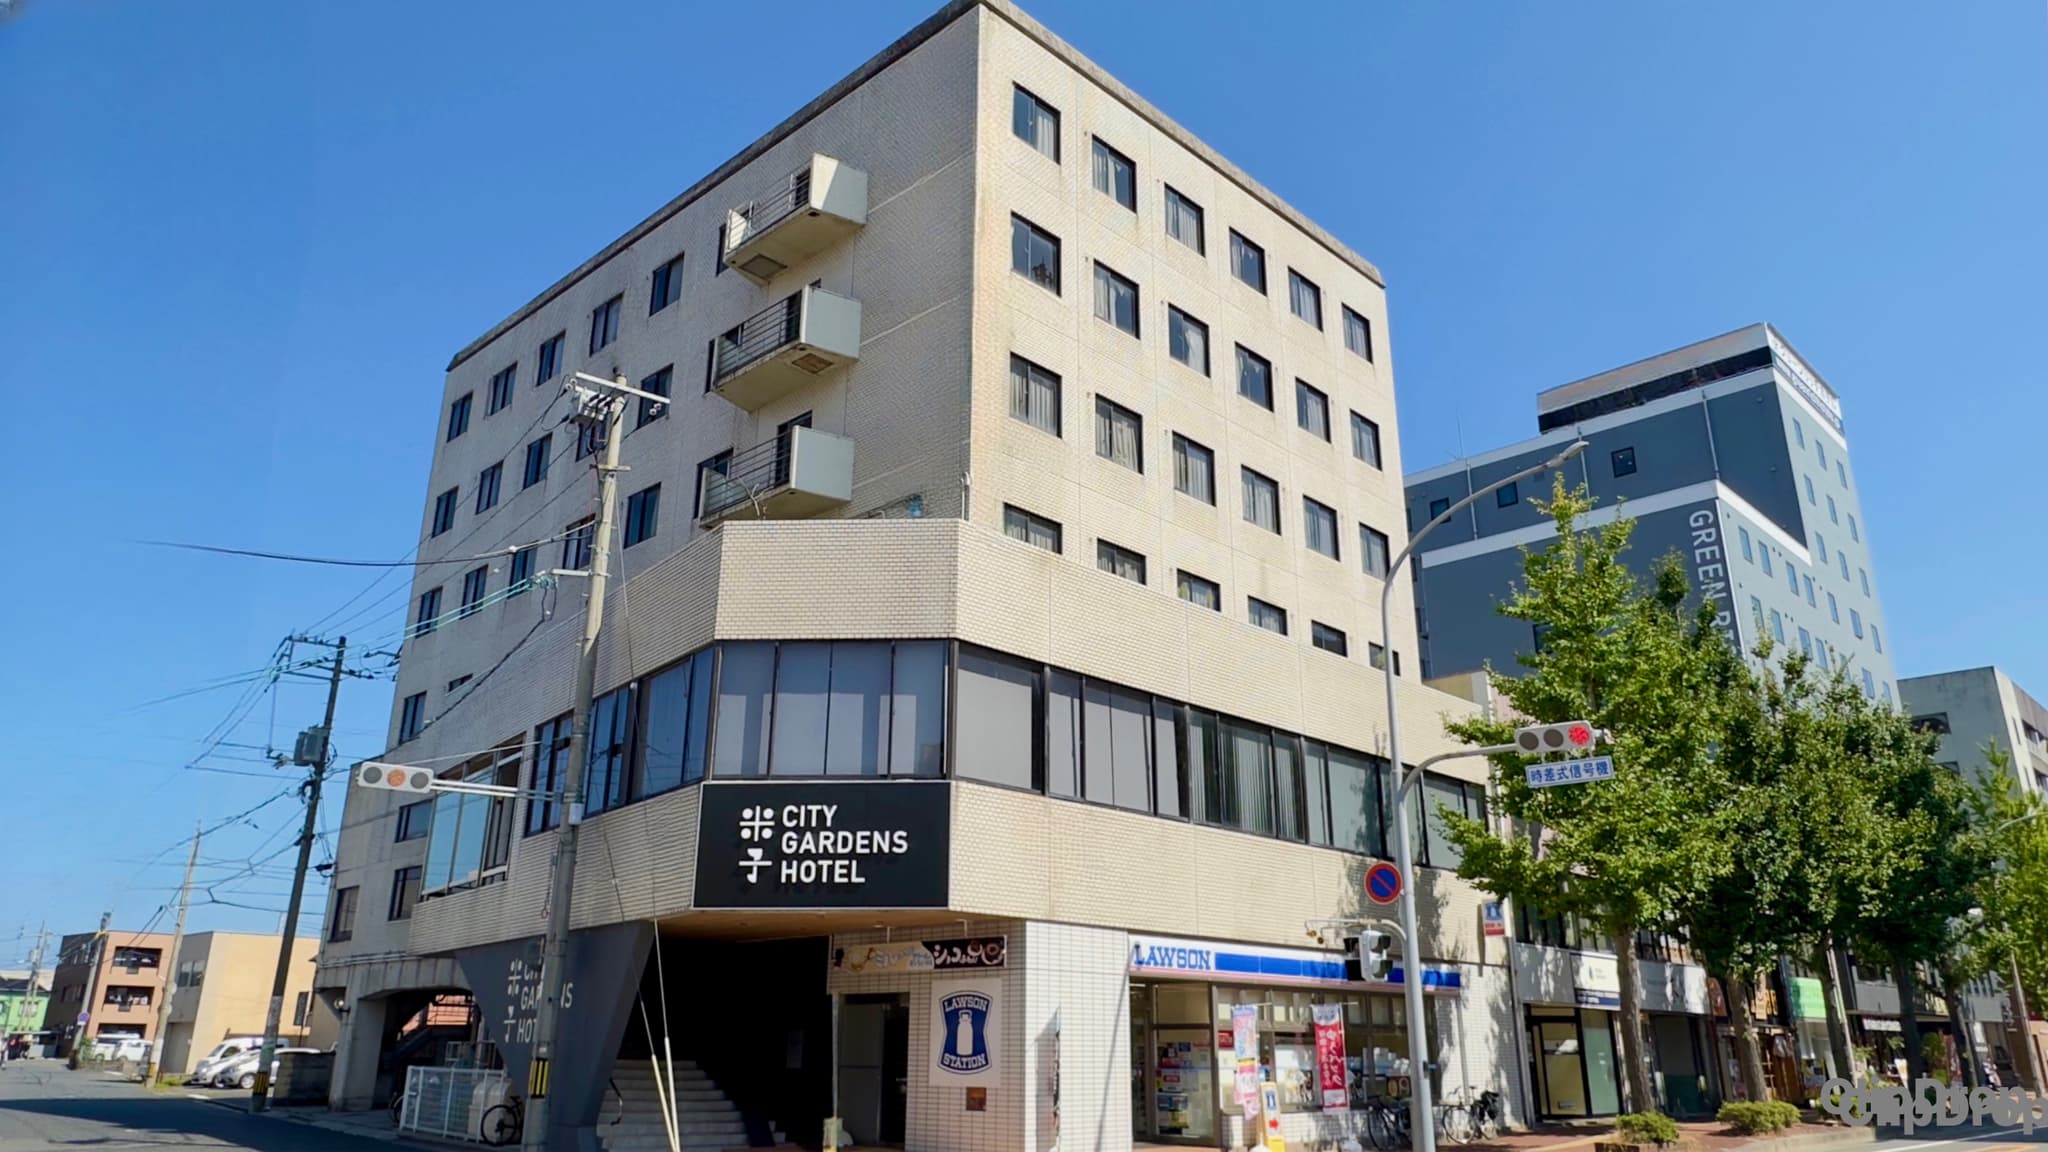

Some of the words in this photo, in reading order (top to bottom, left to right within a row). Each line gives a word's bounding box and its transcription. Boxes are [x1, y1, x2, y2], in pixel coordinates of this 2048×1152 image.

[1689, 510, 1727, 602] GREEN
[1530, 761, 1609, 782] 時差式信号機
[782, 804, 838, 828] CITY
[781, 830, 908, 854] GARDENS
[780, 859, 866, 884] HOTEL
[1134, 944, 1211, 970] LAWSON
[944, 996, 987, 1012] LAWSON
[943, 1053, 986, 1069] STATION
